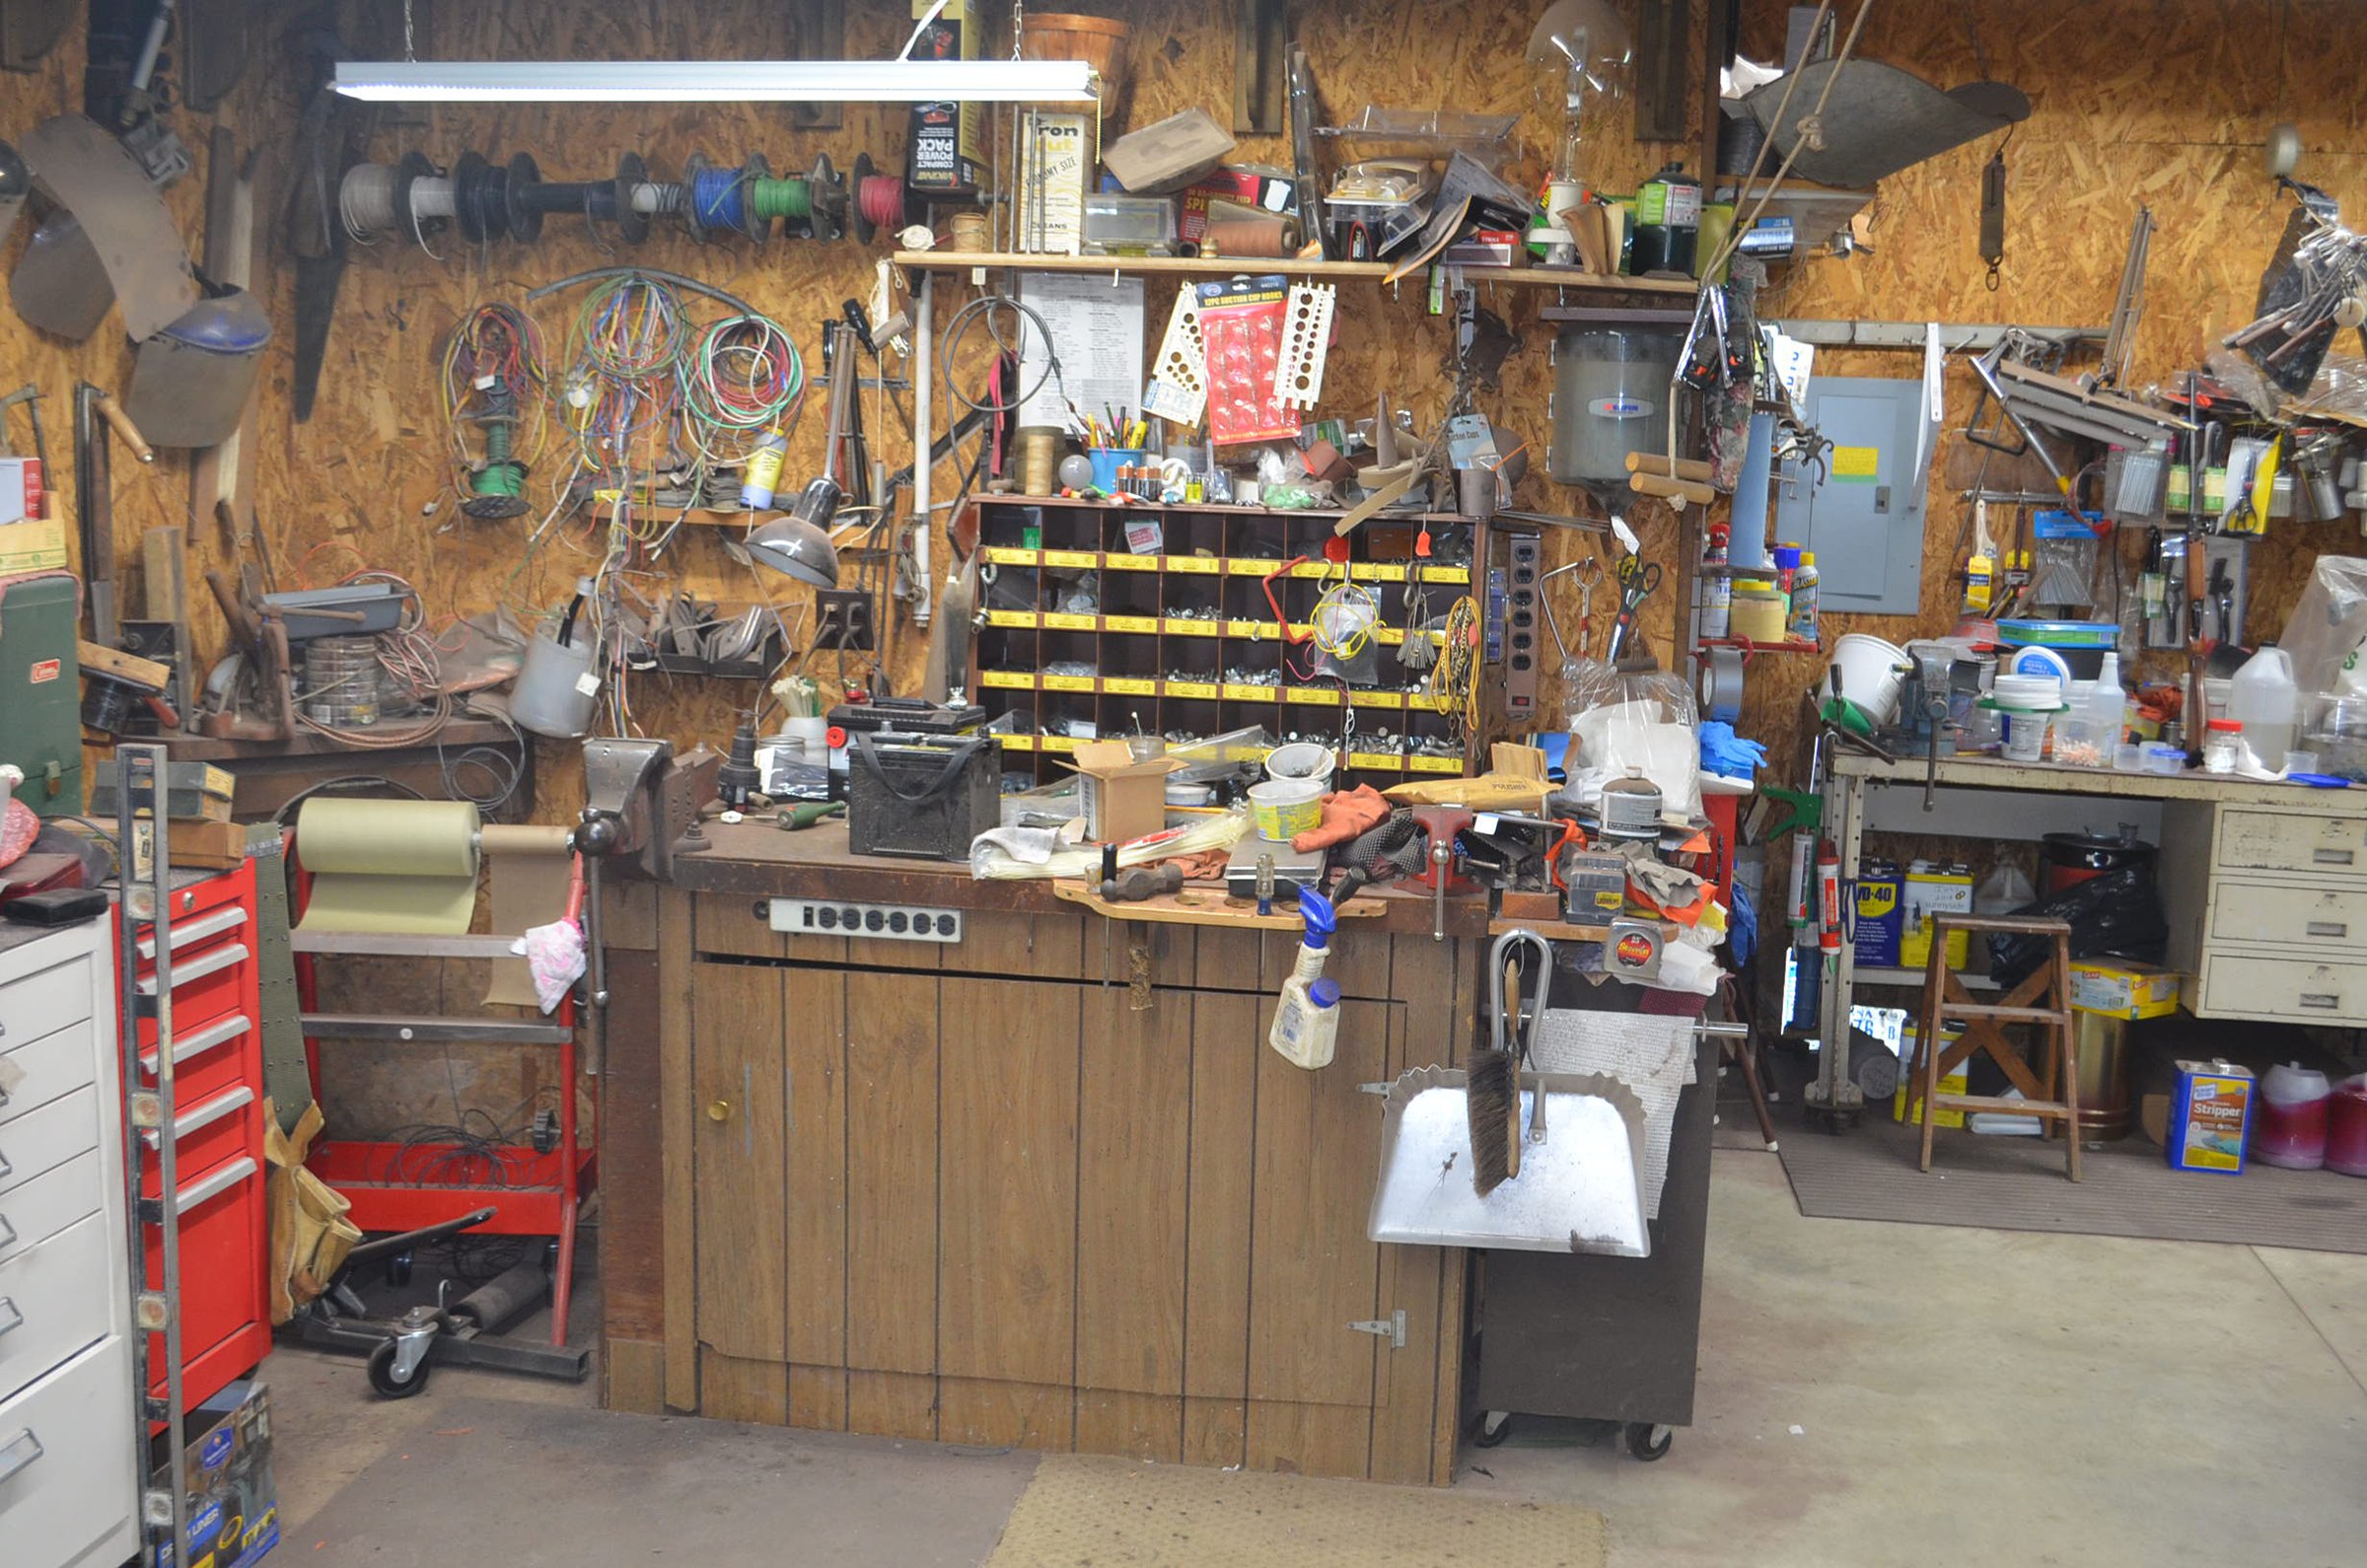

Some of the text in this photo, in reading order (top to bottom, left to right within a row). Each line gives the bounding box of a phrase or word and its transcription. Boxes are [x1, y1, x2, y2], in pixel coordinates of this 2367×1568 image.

[917, 138, 954, 151] PACK
[916, 151, 954, 161] POWER
[2193, 1103, 2242, 1117] Stripper
